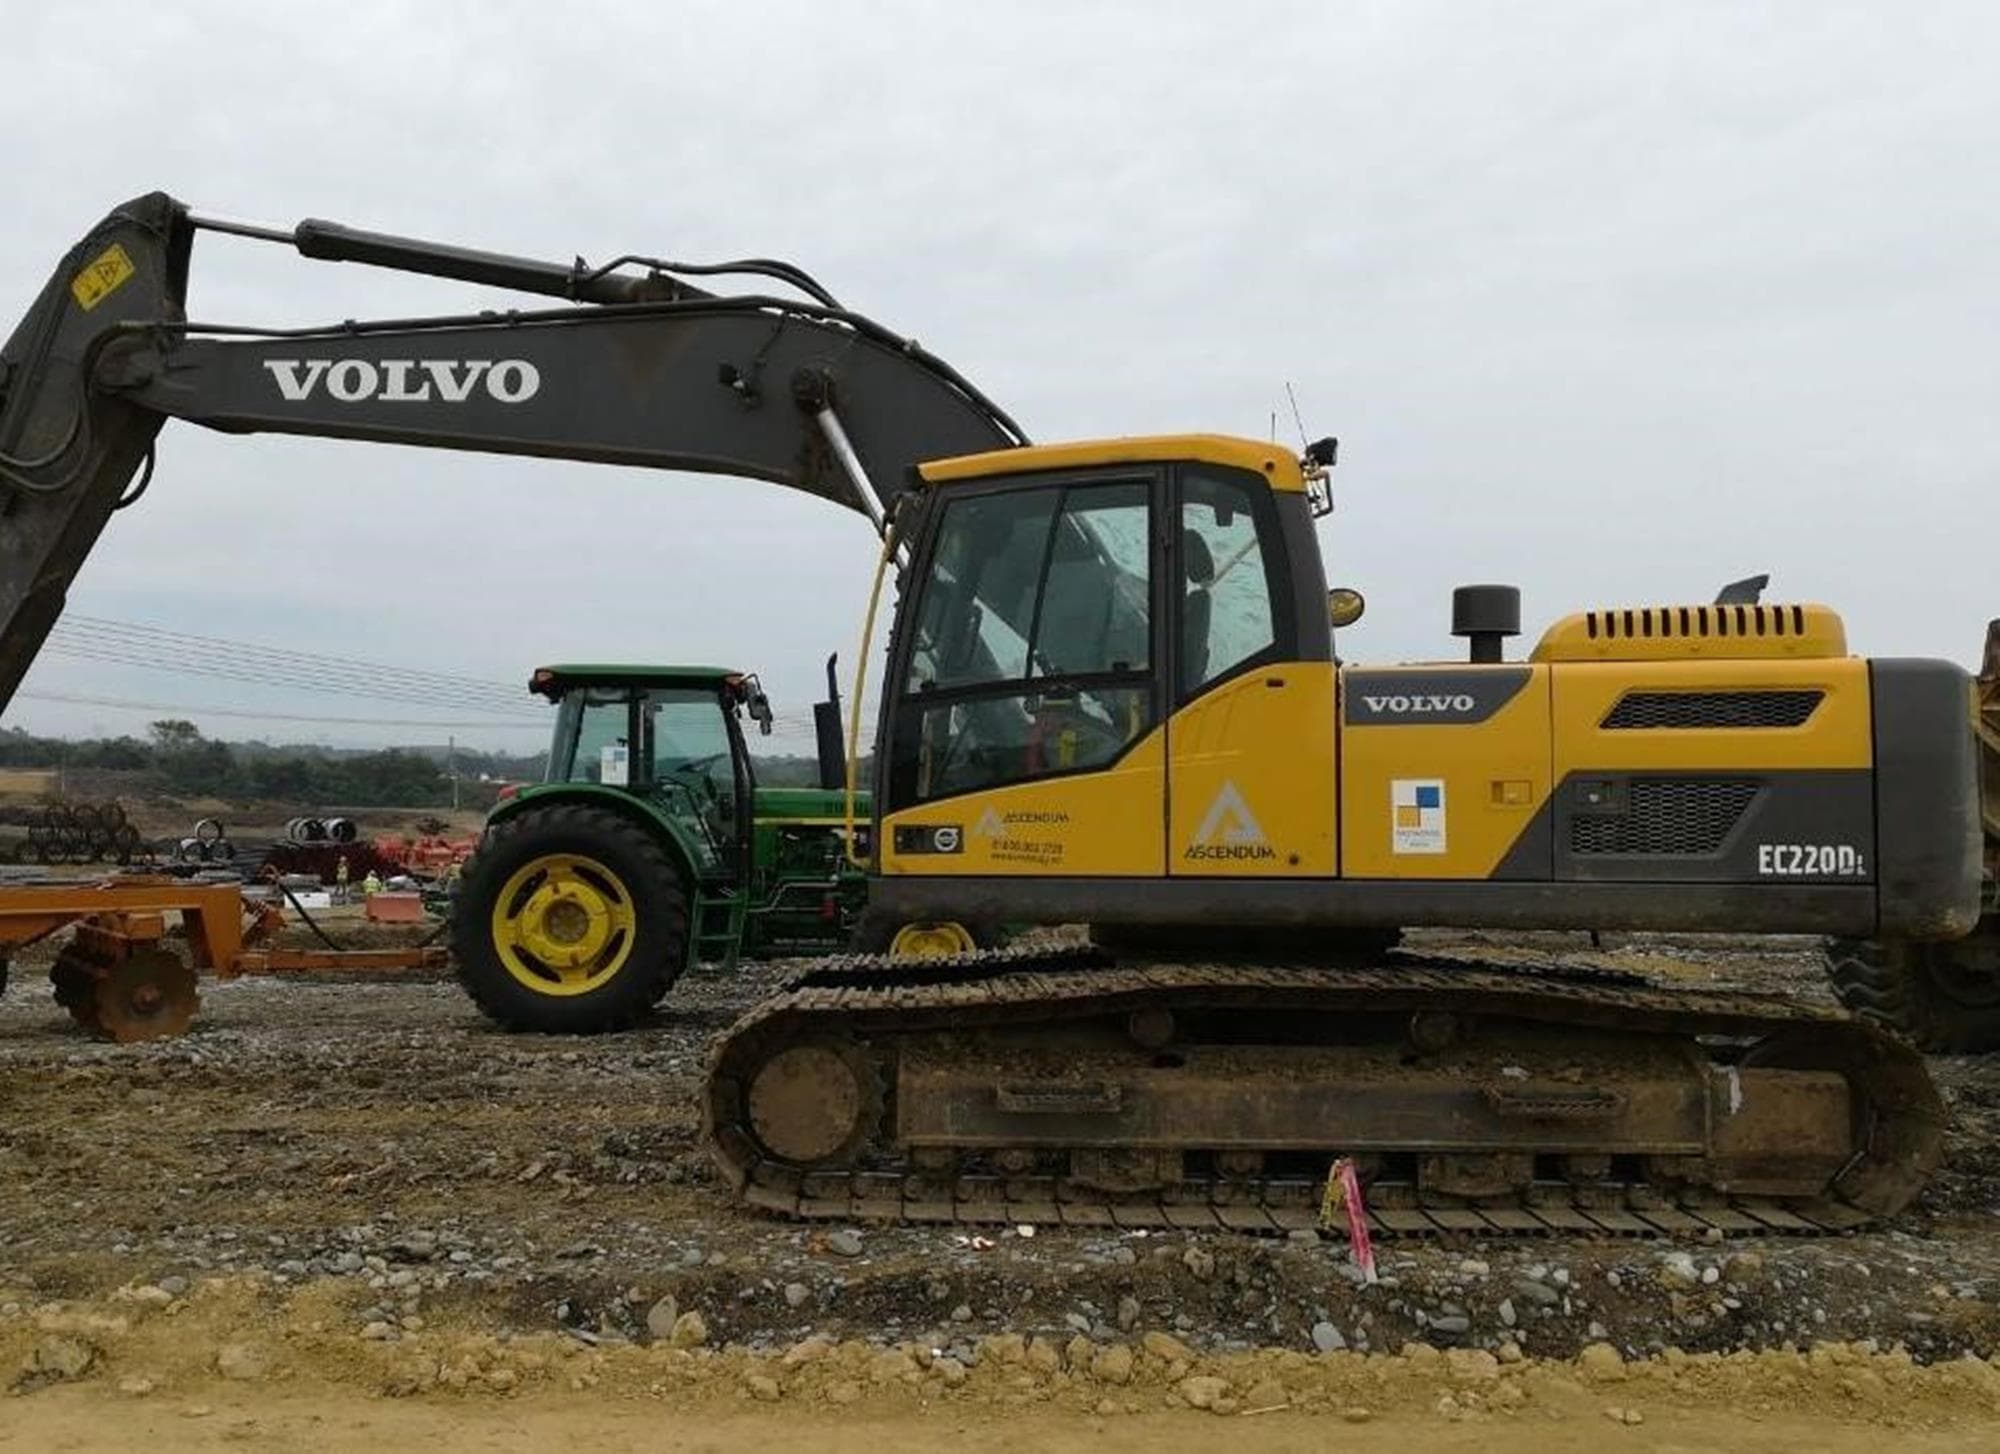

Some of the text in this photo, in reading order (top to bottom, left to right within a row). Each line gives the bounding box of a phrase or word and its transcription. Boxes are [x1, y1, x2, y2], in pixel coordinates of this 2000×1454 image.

[263, 359, 541, 402] VOLVO
[1362, 694, 1475, 713] VOLVO
[1184, 845, 1276, 859] ASCENDUM
